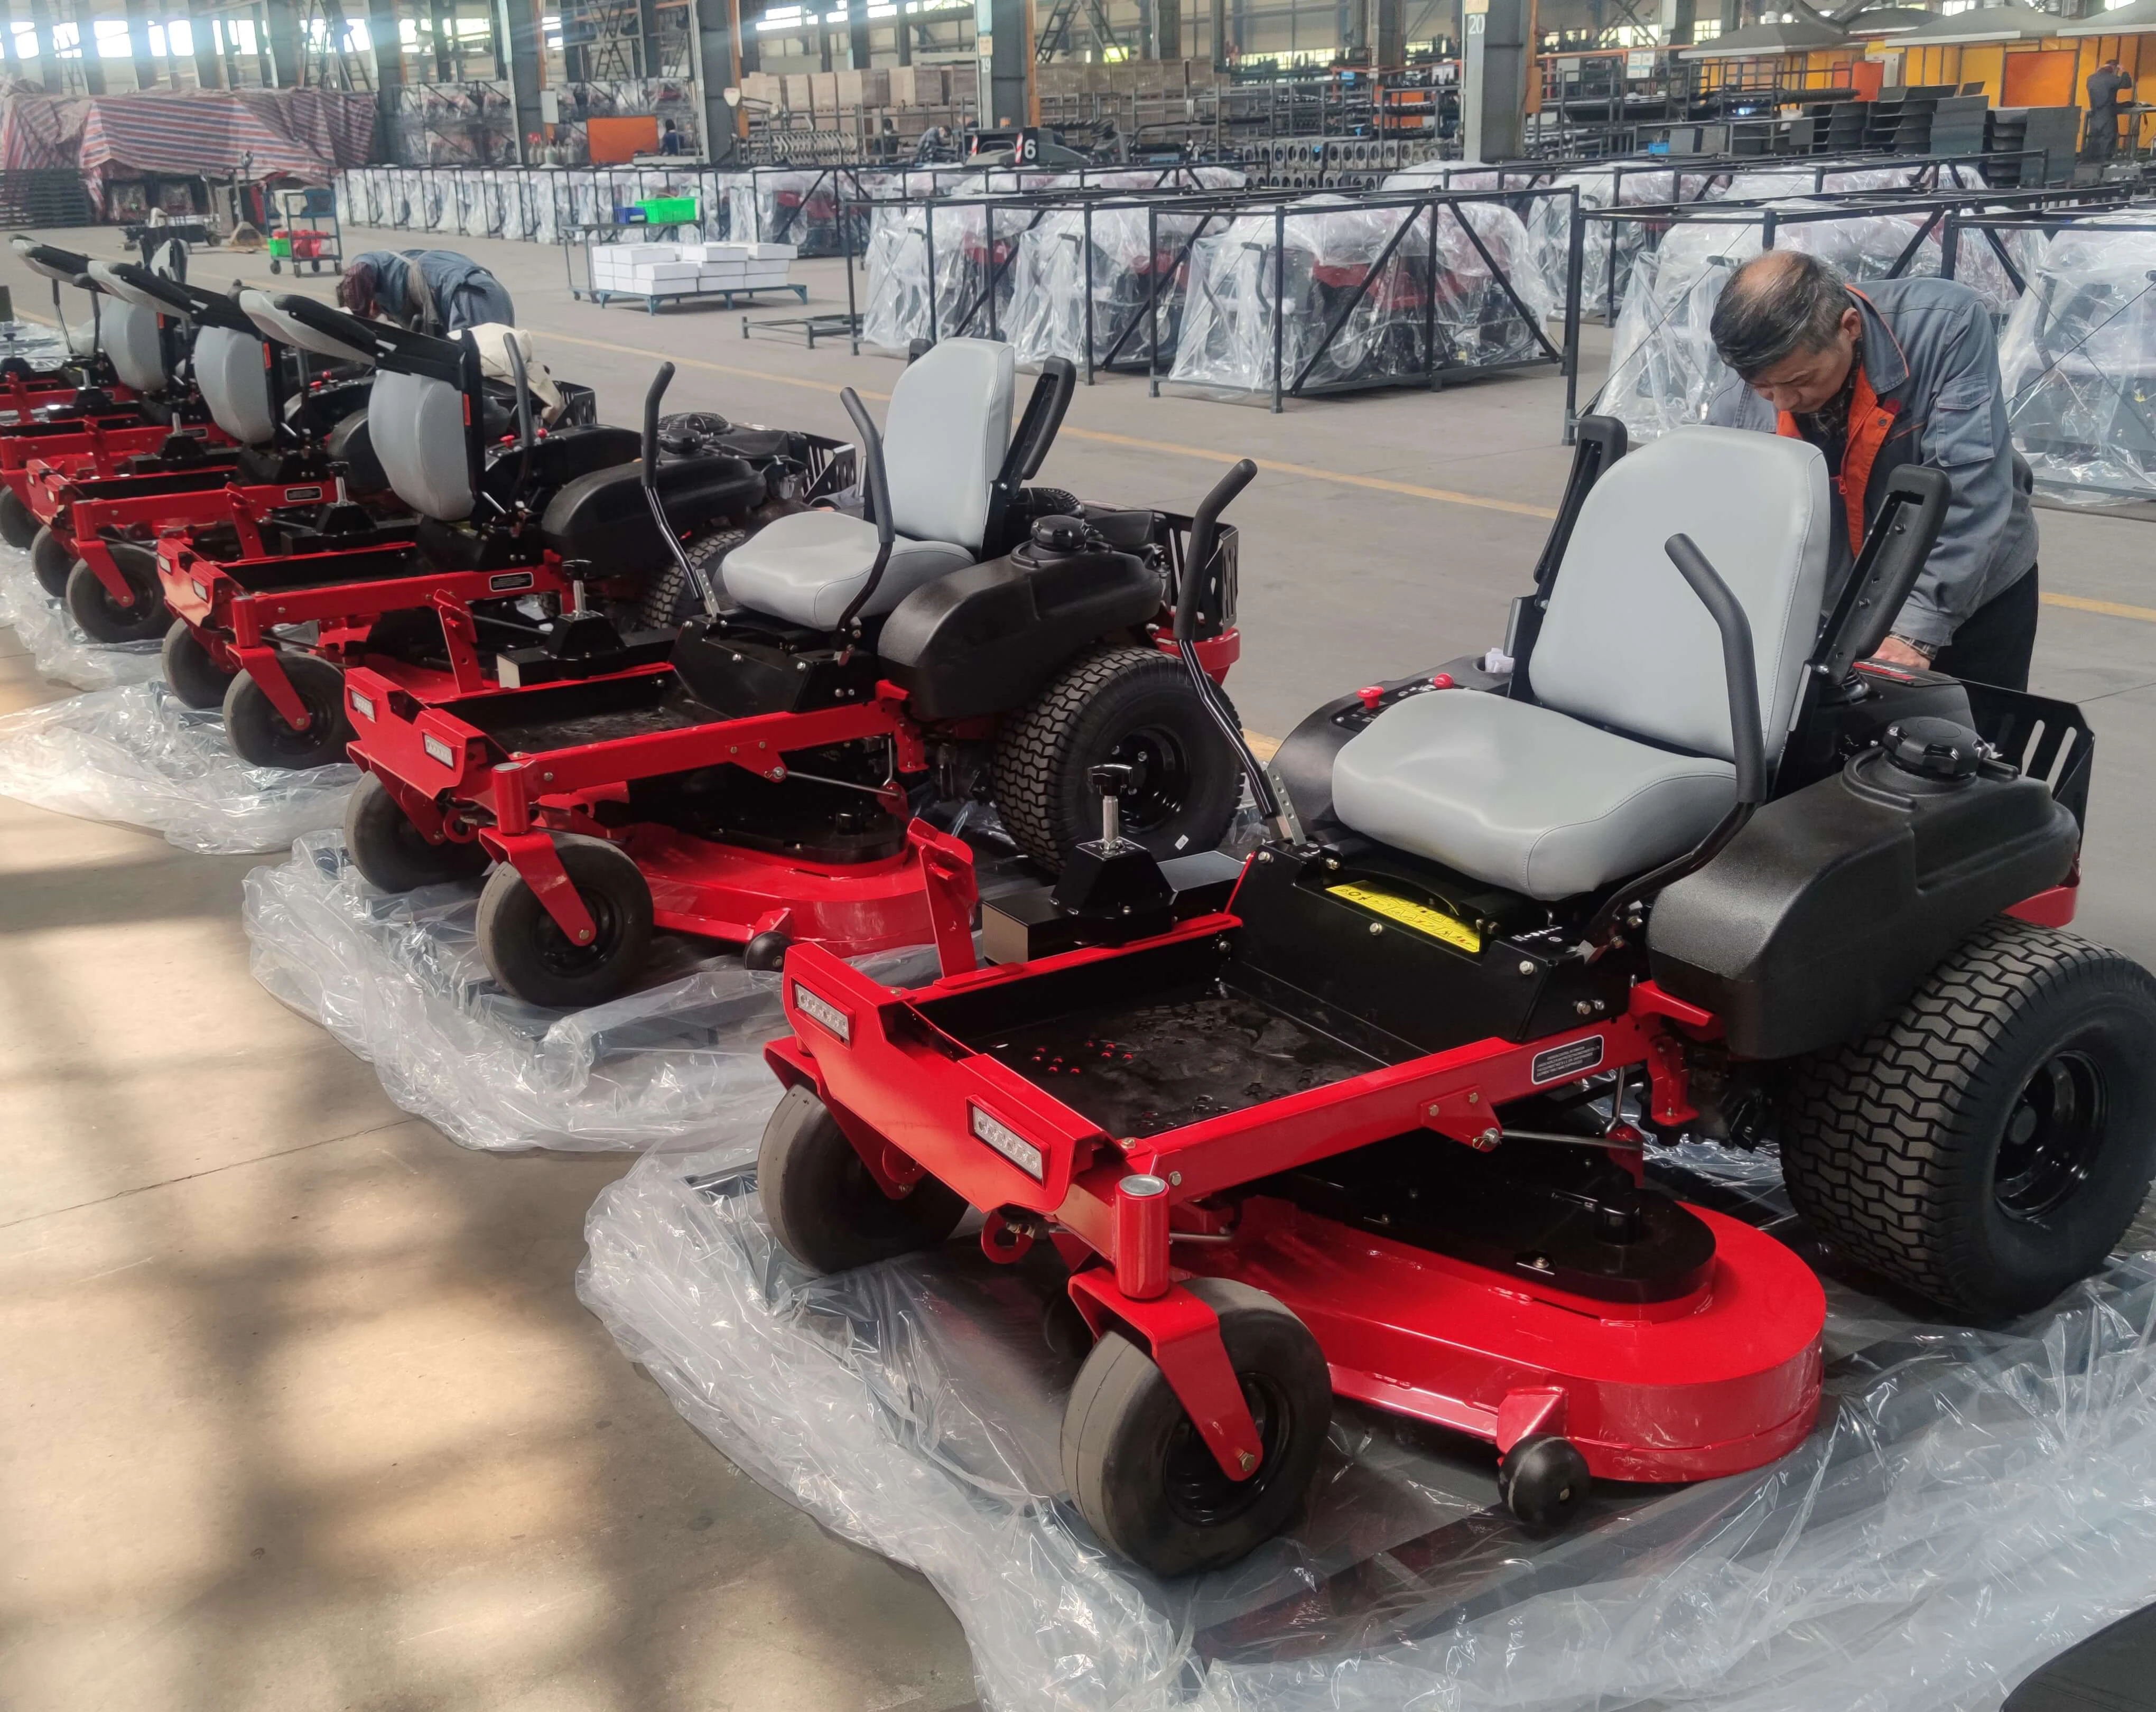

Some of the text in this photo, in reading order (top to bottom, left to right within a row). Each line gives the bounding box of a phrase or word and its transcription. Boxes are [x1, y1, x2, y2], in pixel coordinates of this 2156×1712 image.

[1468, 14, 1485, 34] 20
[981, 58, 991, 72] 19
[1024, 139, 1036, 160] 6
